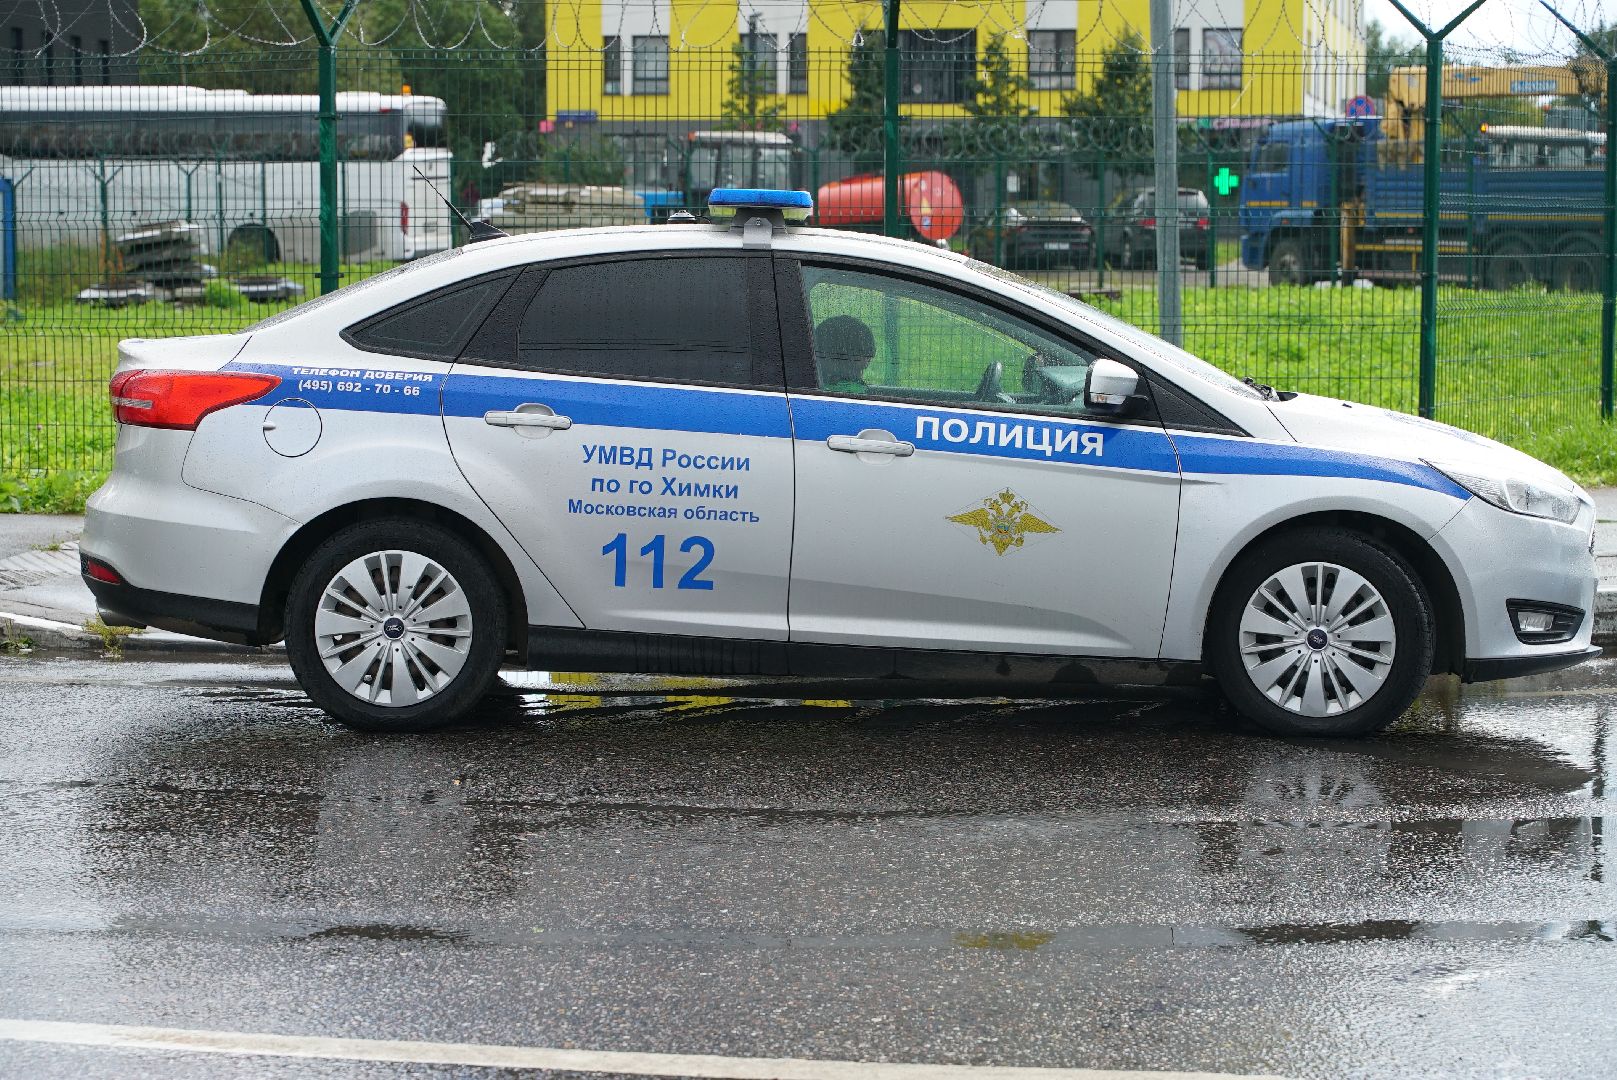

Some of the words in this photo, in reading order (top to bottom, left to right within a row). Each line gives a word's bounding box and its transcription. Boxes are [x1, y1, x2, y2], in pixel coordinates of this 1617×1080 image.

[293, 367, 360, 377] ТЕЛЕФОН
[363, 371, 433, 382] ДОВЕРИЯ
[298, 380, 332, 392] (495)
[337, 382, 362, 393] 692
[375, 384, 391, 394] 70
[403, 386, 420, 396] 66
[915, 416, 1104, 457] ПОЛИЦИЯ
[582, 444, 653, 470] УМВД
[661, 448, 750, 471] России
[591, 477, 620, 492] по
[629, 480, 653, 494] го
[660, 476, 739, 499] Химки
[568, 498, 678, 519] Московская
[684, 506, 760, 523] область
[602, 532, 715, 590] 112
